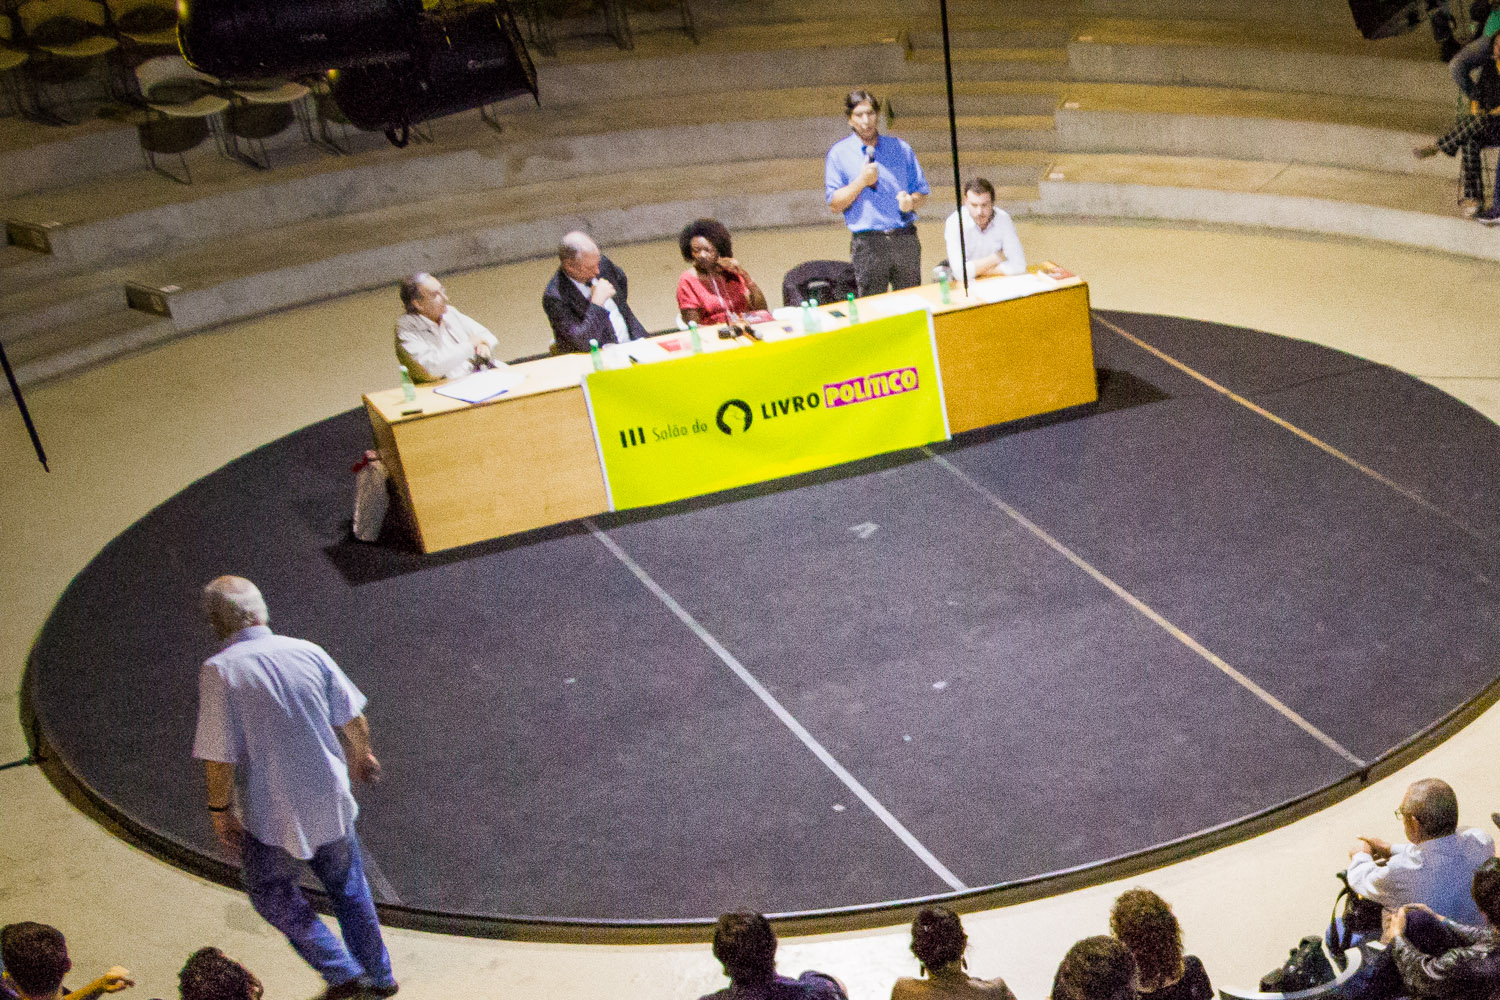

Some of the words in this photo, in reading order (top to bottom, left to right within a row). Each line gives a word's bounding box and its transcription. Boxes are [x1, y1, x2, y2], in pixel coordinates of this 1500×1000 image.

[619, 426, 646, 448] III
[652, 423, 688, 443] Salão
[692, 418, 708, 436] do
[761, 392, 820, 419] LIVRO
[824, 368, 918, 408] POLÍTICO
